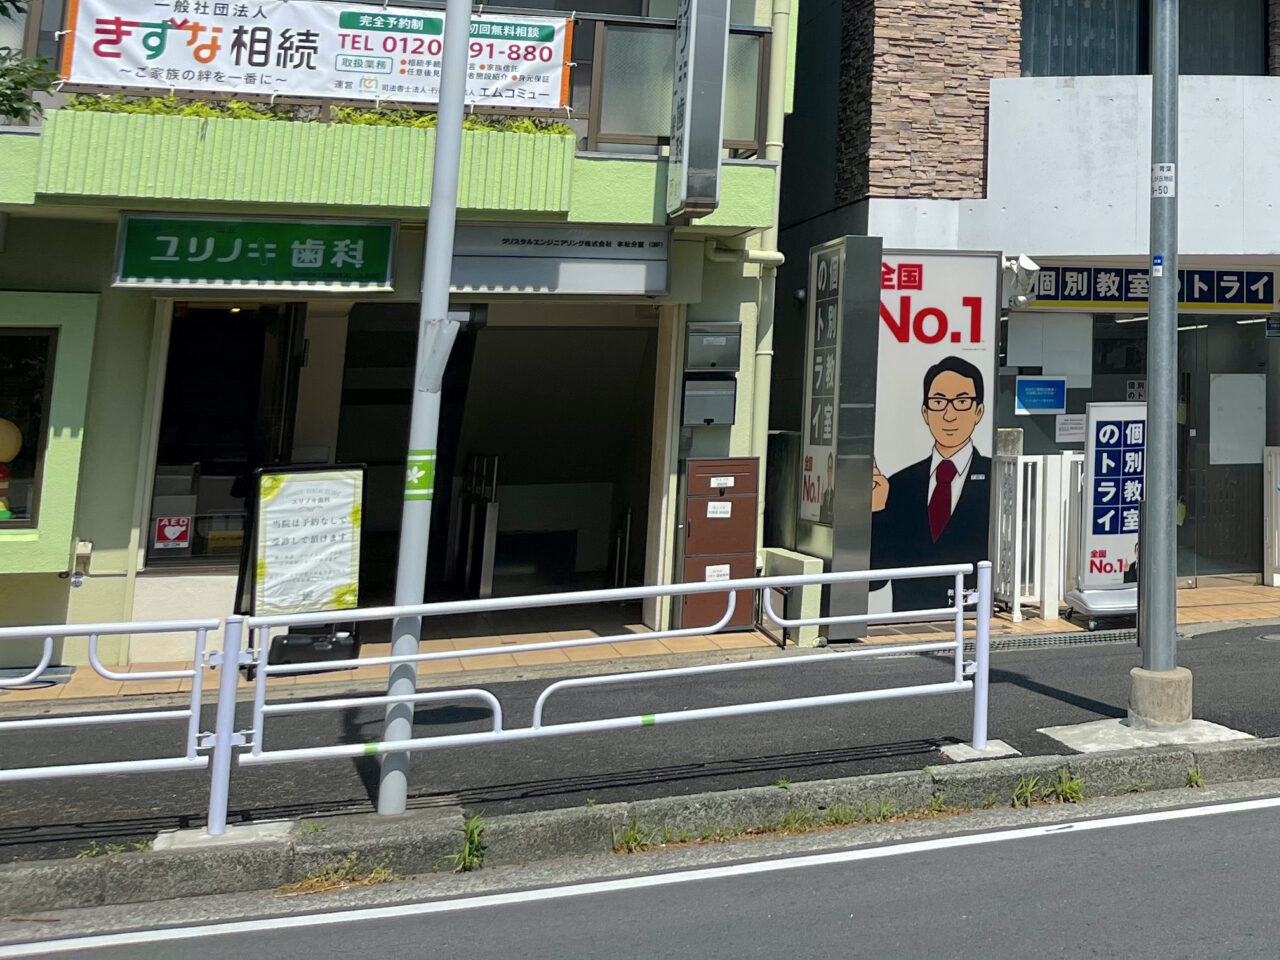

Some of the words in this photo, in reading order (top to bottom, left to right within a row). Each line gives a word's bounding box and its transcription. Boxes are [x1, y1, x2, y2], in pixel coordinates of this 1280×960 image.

[154, 0, 268, 19] 一般社団法人
[359, 15, 424, 31] 完全予約制
[93, 16, 320, 70] きずな相続
[338, 33, 374, 51] TEL
[342, 57, 387, 70] 取扱業務
[479, 87, 550, 100] エムコミュー
[1029, 270, 1270, 300] 個別教室トライ
[880, 295, 982, 345] No.1
[1097, 424, 1120, 532] のトライ
[1122, 423, 1144, 531] 個別教室
[160, 518, 188, 526] AED
[1089, 558, 1124, 574] No.1
